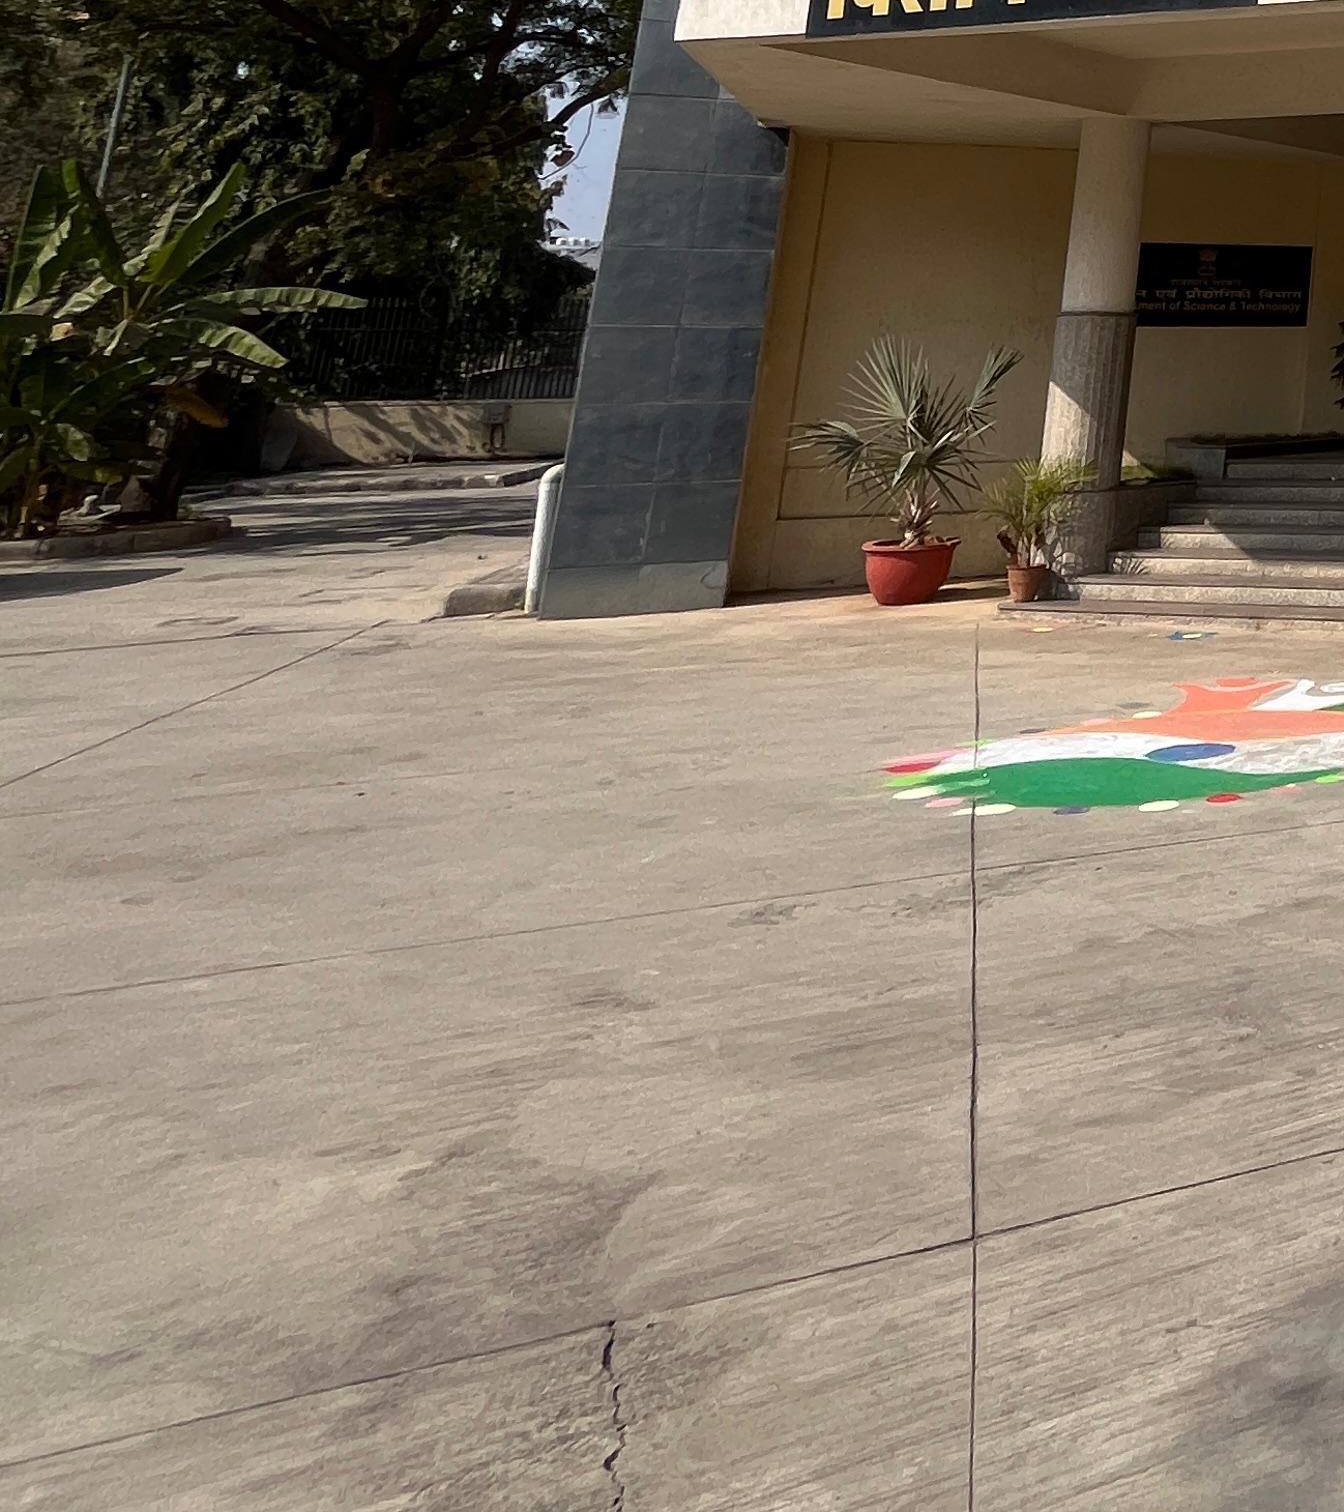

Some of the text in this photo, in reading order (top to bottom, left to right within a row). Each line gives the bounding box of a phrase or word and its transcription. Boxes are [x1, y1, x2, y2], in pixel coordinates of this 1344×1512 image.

[1169, 301, 1182, 311] of
[1183, 301, 1226, 311] Science
[1229, 301, 1237, 311] &
[1240, 301, 1302, 315] Technology
